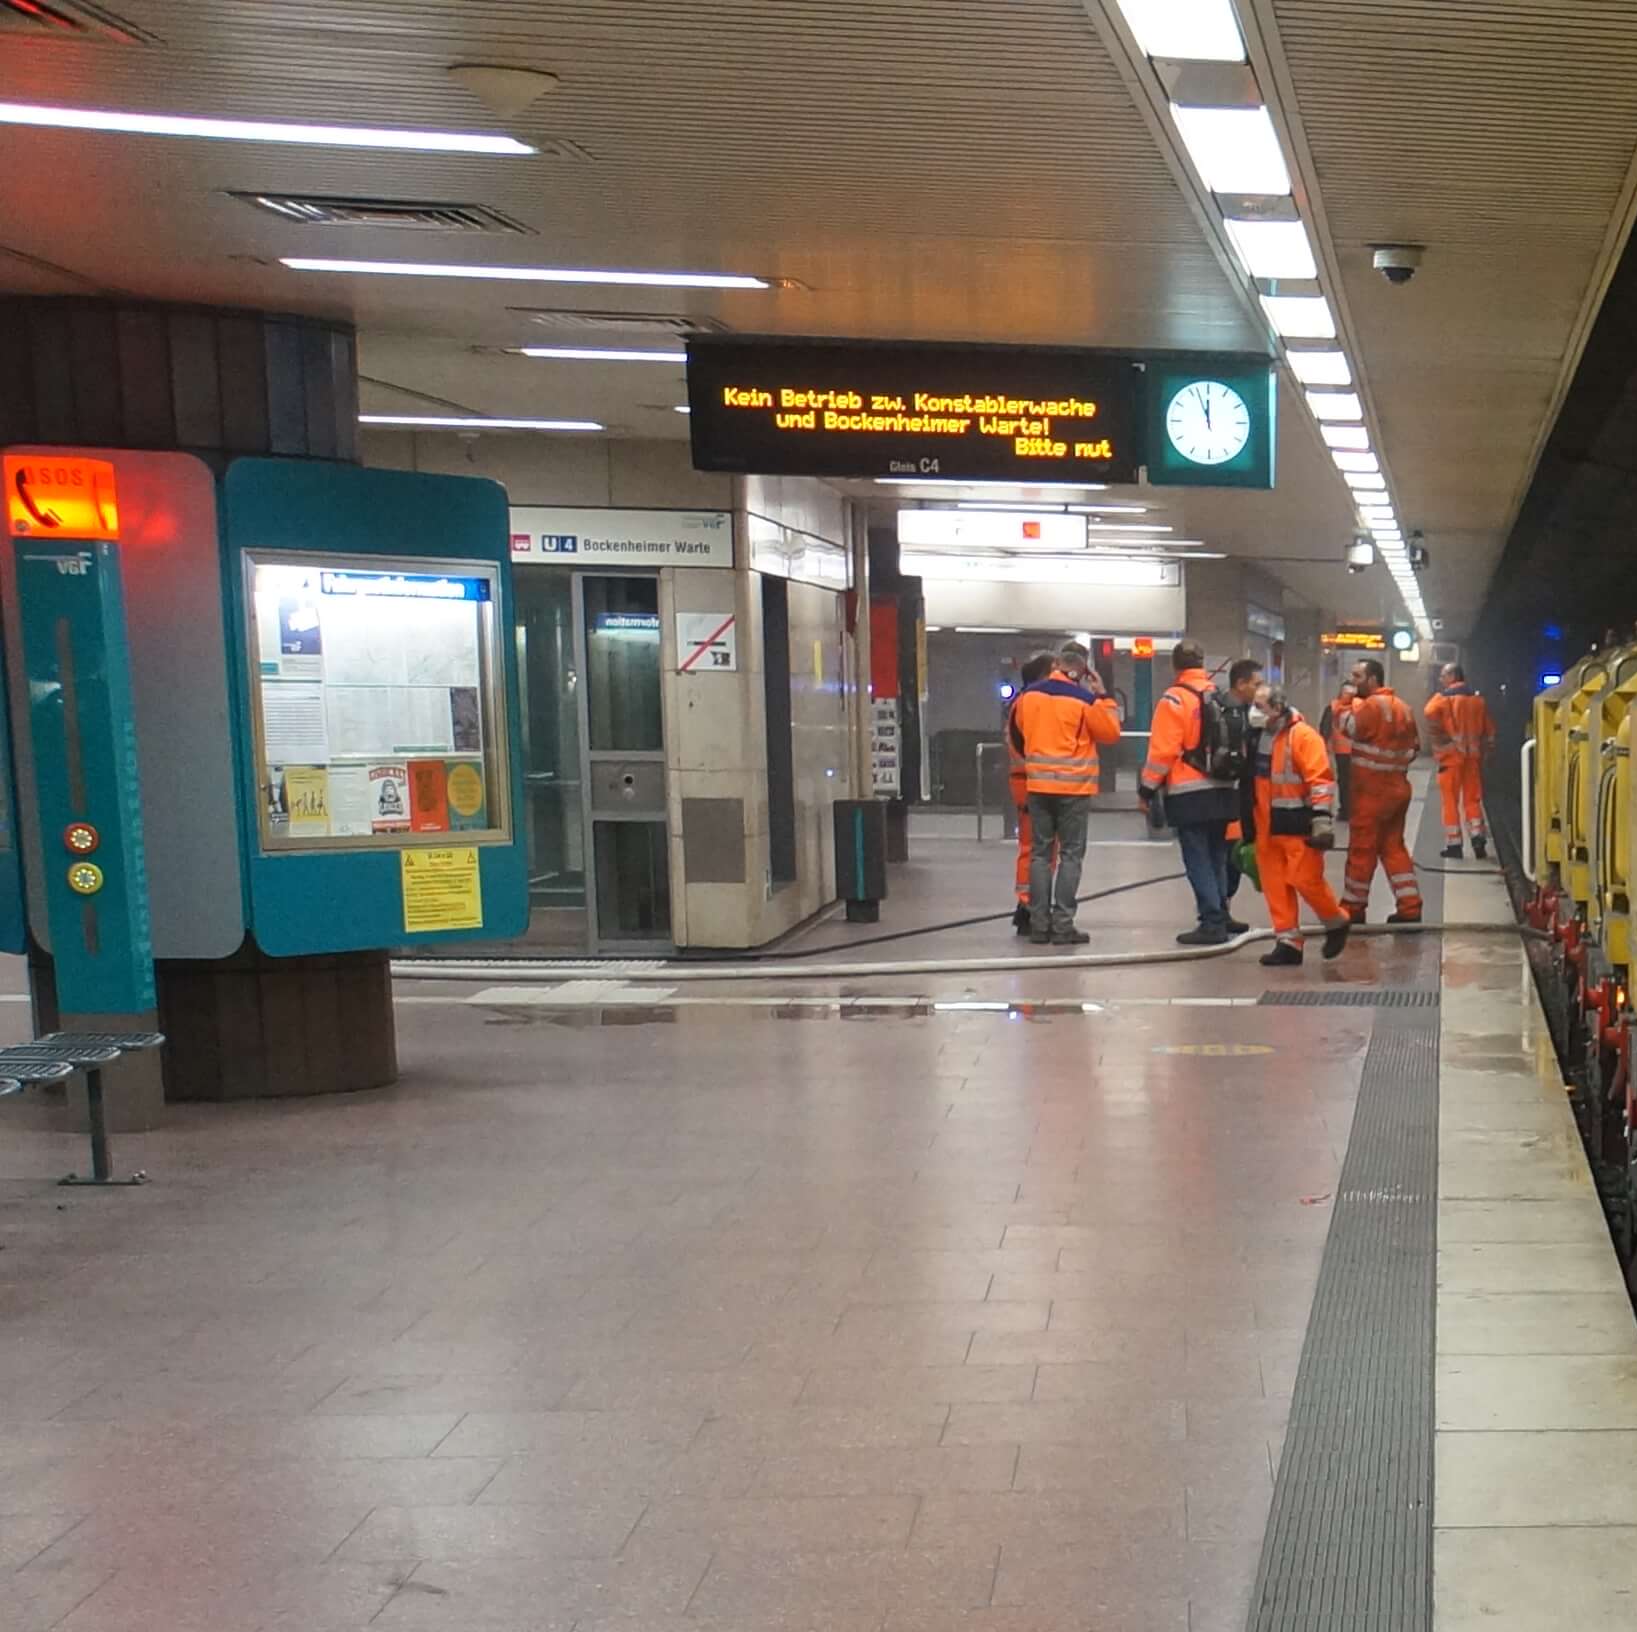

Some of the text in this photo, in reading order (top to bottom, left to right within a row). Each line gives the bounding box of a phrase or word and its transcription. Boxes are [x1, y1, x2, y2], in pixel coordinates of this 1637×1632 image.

[724, 387, 1096, 417] Kein Betrieb zw. Konstablerwache
[776, 411, 1049, 436] und Bockenheimer Warte!
[1015, 437, 1067, 457] Bitte
[920, 457, 939, 473] C4
[40, 467, 83, 486] SOS
[543, 535, 557, 549] U
[583, 538, 671, 553] Bockenheimer
[675, 540, 710, 554] Warte
